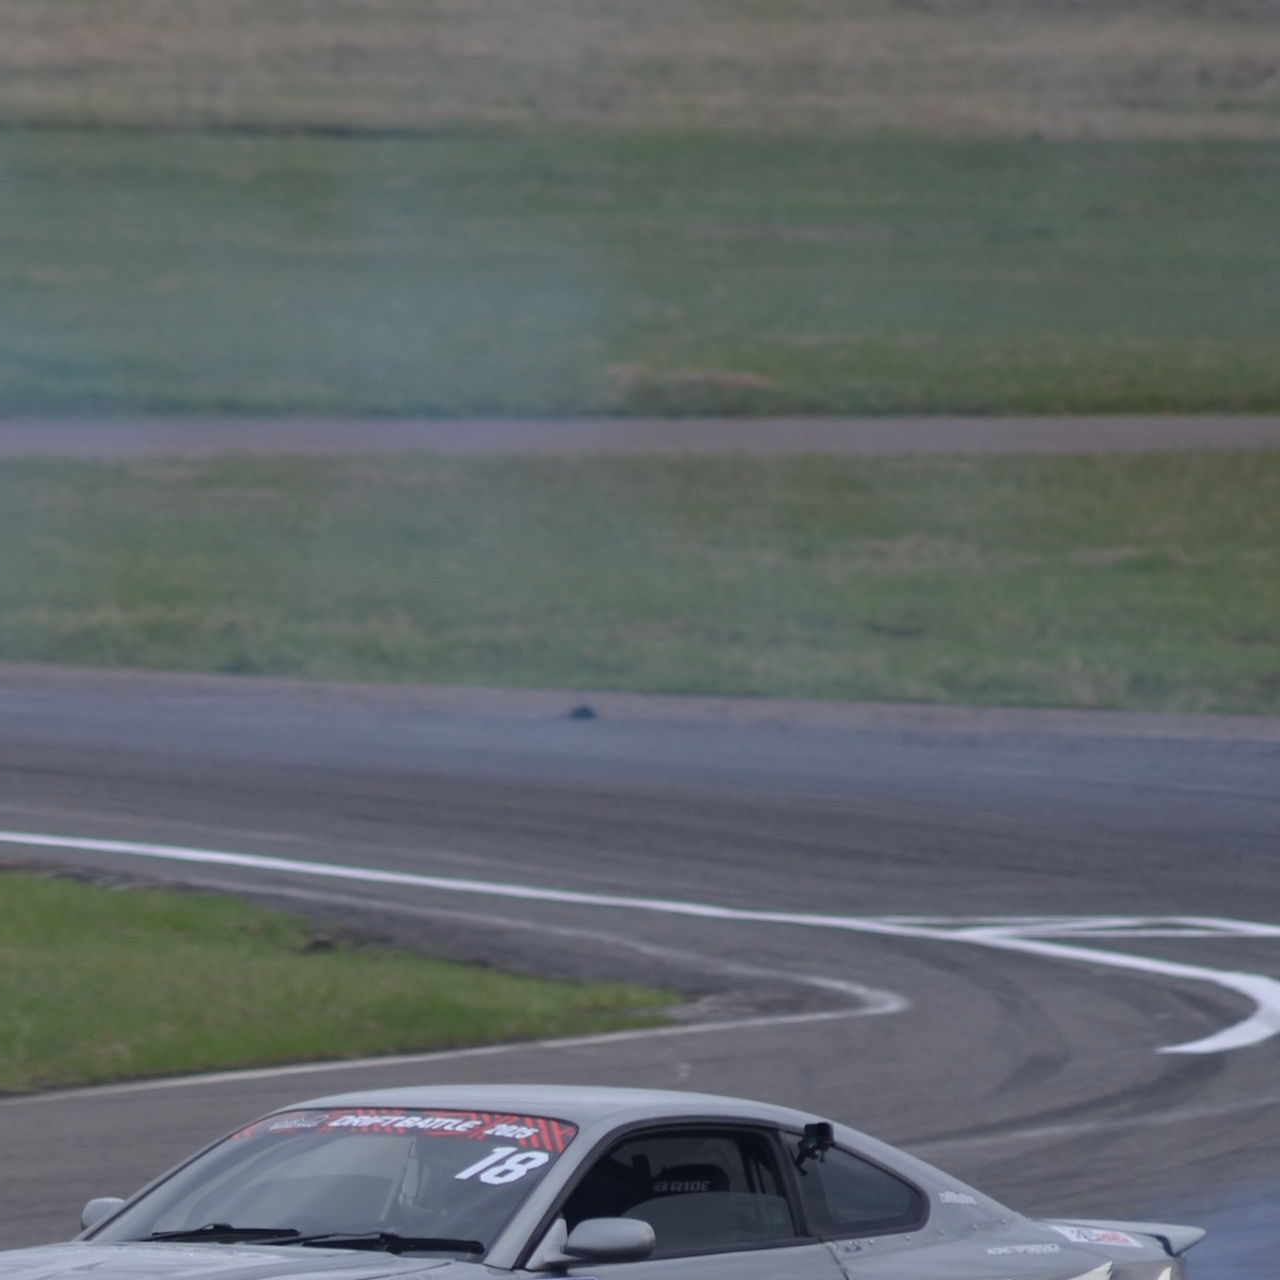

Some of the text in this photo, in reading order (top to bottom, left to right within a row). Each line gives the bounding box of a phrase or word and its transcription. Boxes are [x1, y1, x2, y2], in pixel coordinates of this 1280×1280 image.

[394, 1116, 482, 1131] BATTLE
[454, 1146, 549, 1185] 18
[653, 1180, 711, 1193] BRIDE
